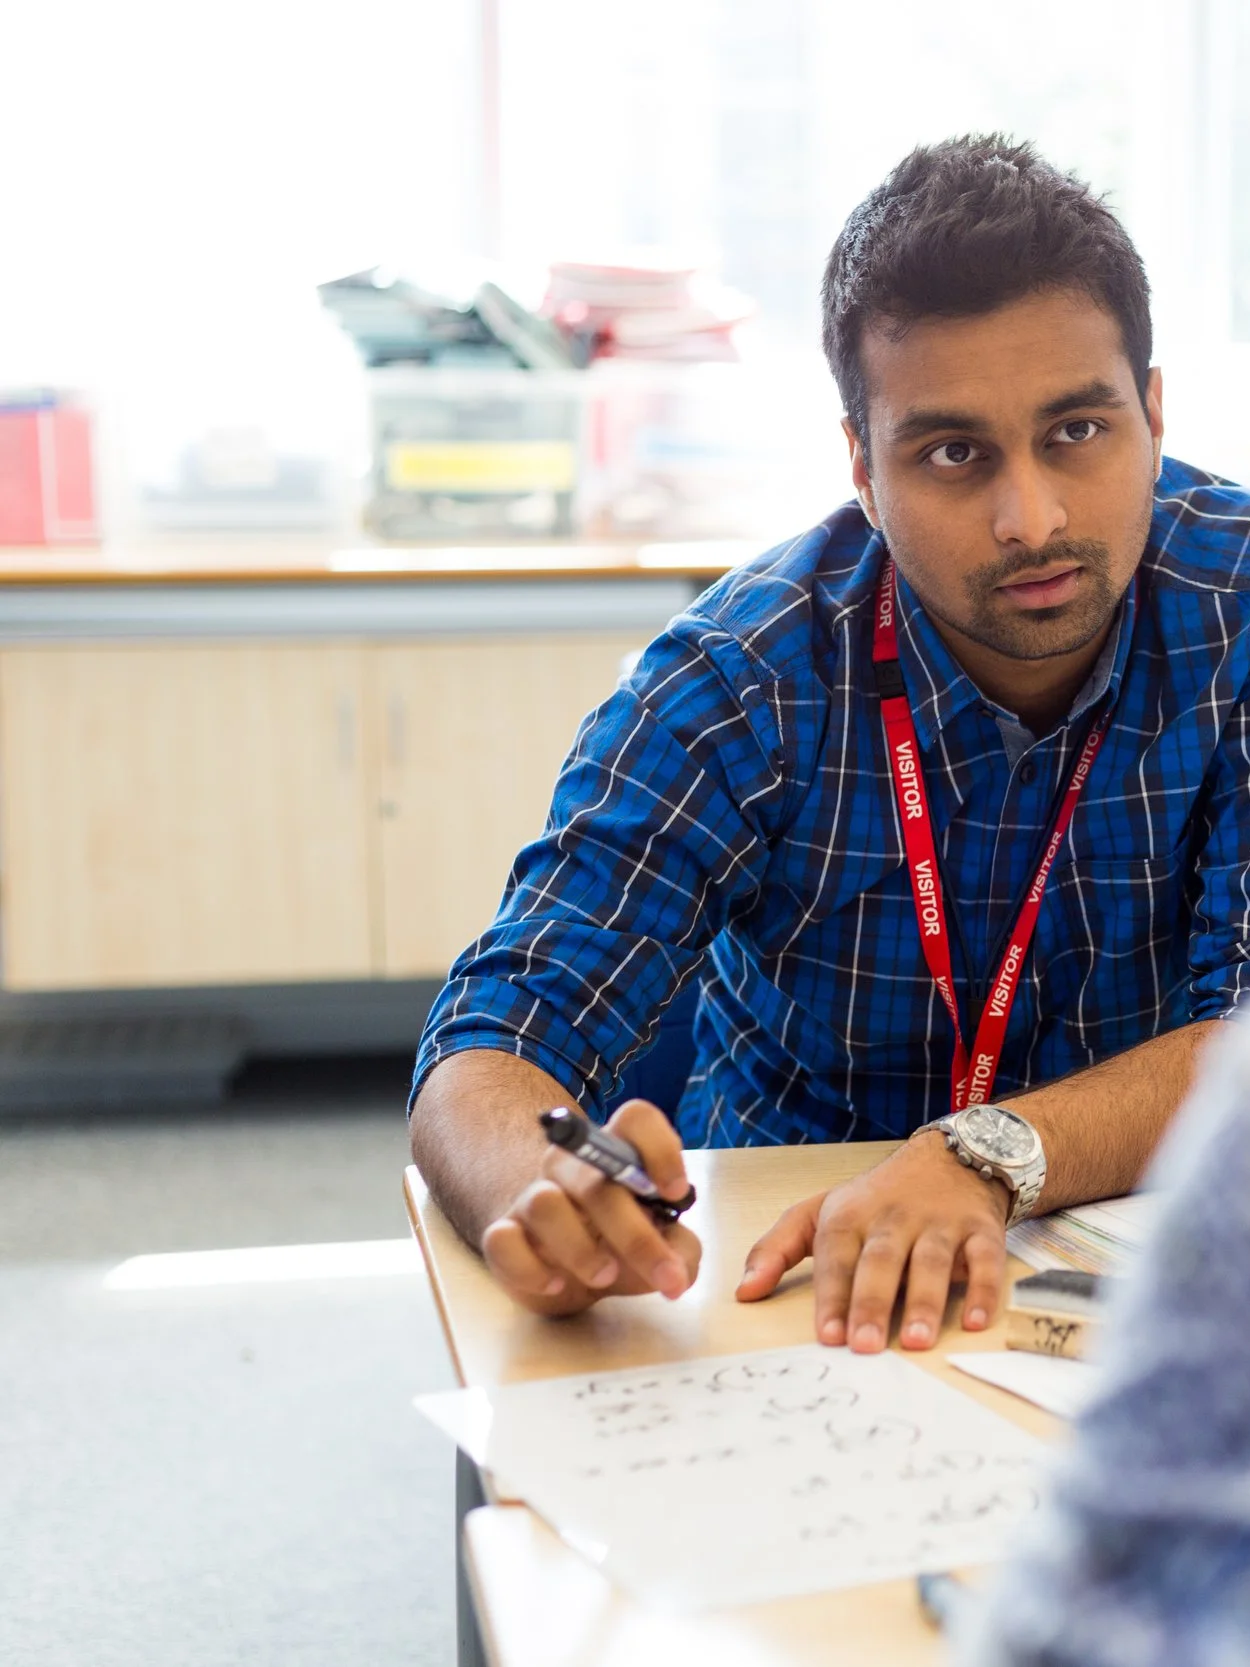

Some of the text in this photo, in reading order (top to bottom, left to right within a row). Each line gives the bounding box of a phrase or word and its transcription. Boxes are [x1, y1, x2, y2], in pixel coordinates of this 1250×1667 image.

[896, 740, 922, 820] VISITOR
[915, 859, 940, 936] VISITOR
[1028, 831, 1062, 903] VISITOR
[989, 944, 1022, 1017] VISITOR
[967, 1053, 994, 1106] ISITOR
